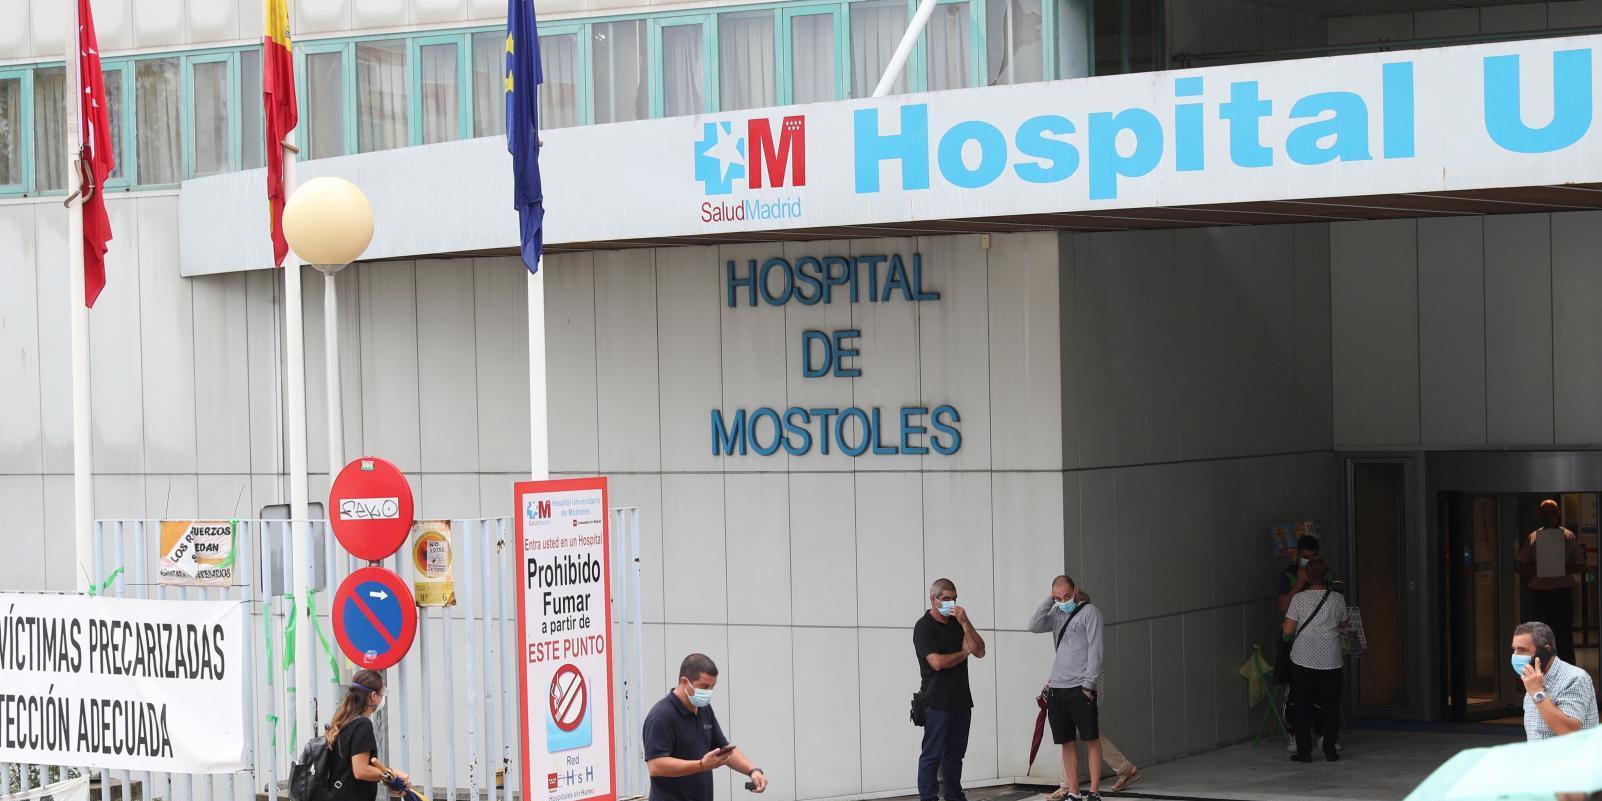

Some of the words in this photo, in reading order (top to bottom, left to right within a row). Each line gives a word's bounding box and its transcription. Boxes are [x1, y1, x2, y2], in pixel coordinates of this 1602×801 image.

[854, 61, 1415, 199] Hospital
[1484, 48, 1592, 153] U
[701, 198, 801, 222] SaludMadrid
[727, 253, 940, 307] HOSPITAL
[802, 329, 861, 378] DE
[711, 404, 962, 456] MOSTOLES
[525, 538, 541, 550] Entra
[543, 536, 560, 550] usted
[561, 537, 568, 548] en
[570, 537, 577, 547] un
[579, 532, 602, 547] Hospital
[528, 553, 601, 589] Prohibido
[543, 592, 591, 616] Fumar
[0, 603, 82, 674] VÍCTIMAS
[89, 618, 225, 681] PRECARIZADAS
[541, 621, 547, 634] a
[551, 616, 576, 636] partir
[579, 614, 591, 629] de
[528, 640, 560, 663] ESTE
[563, 634, 605, 659] PUNTO
[77, 698, 174, 758] ADECUADA
[567, 754, 579, 766] Red
